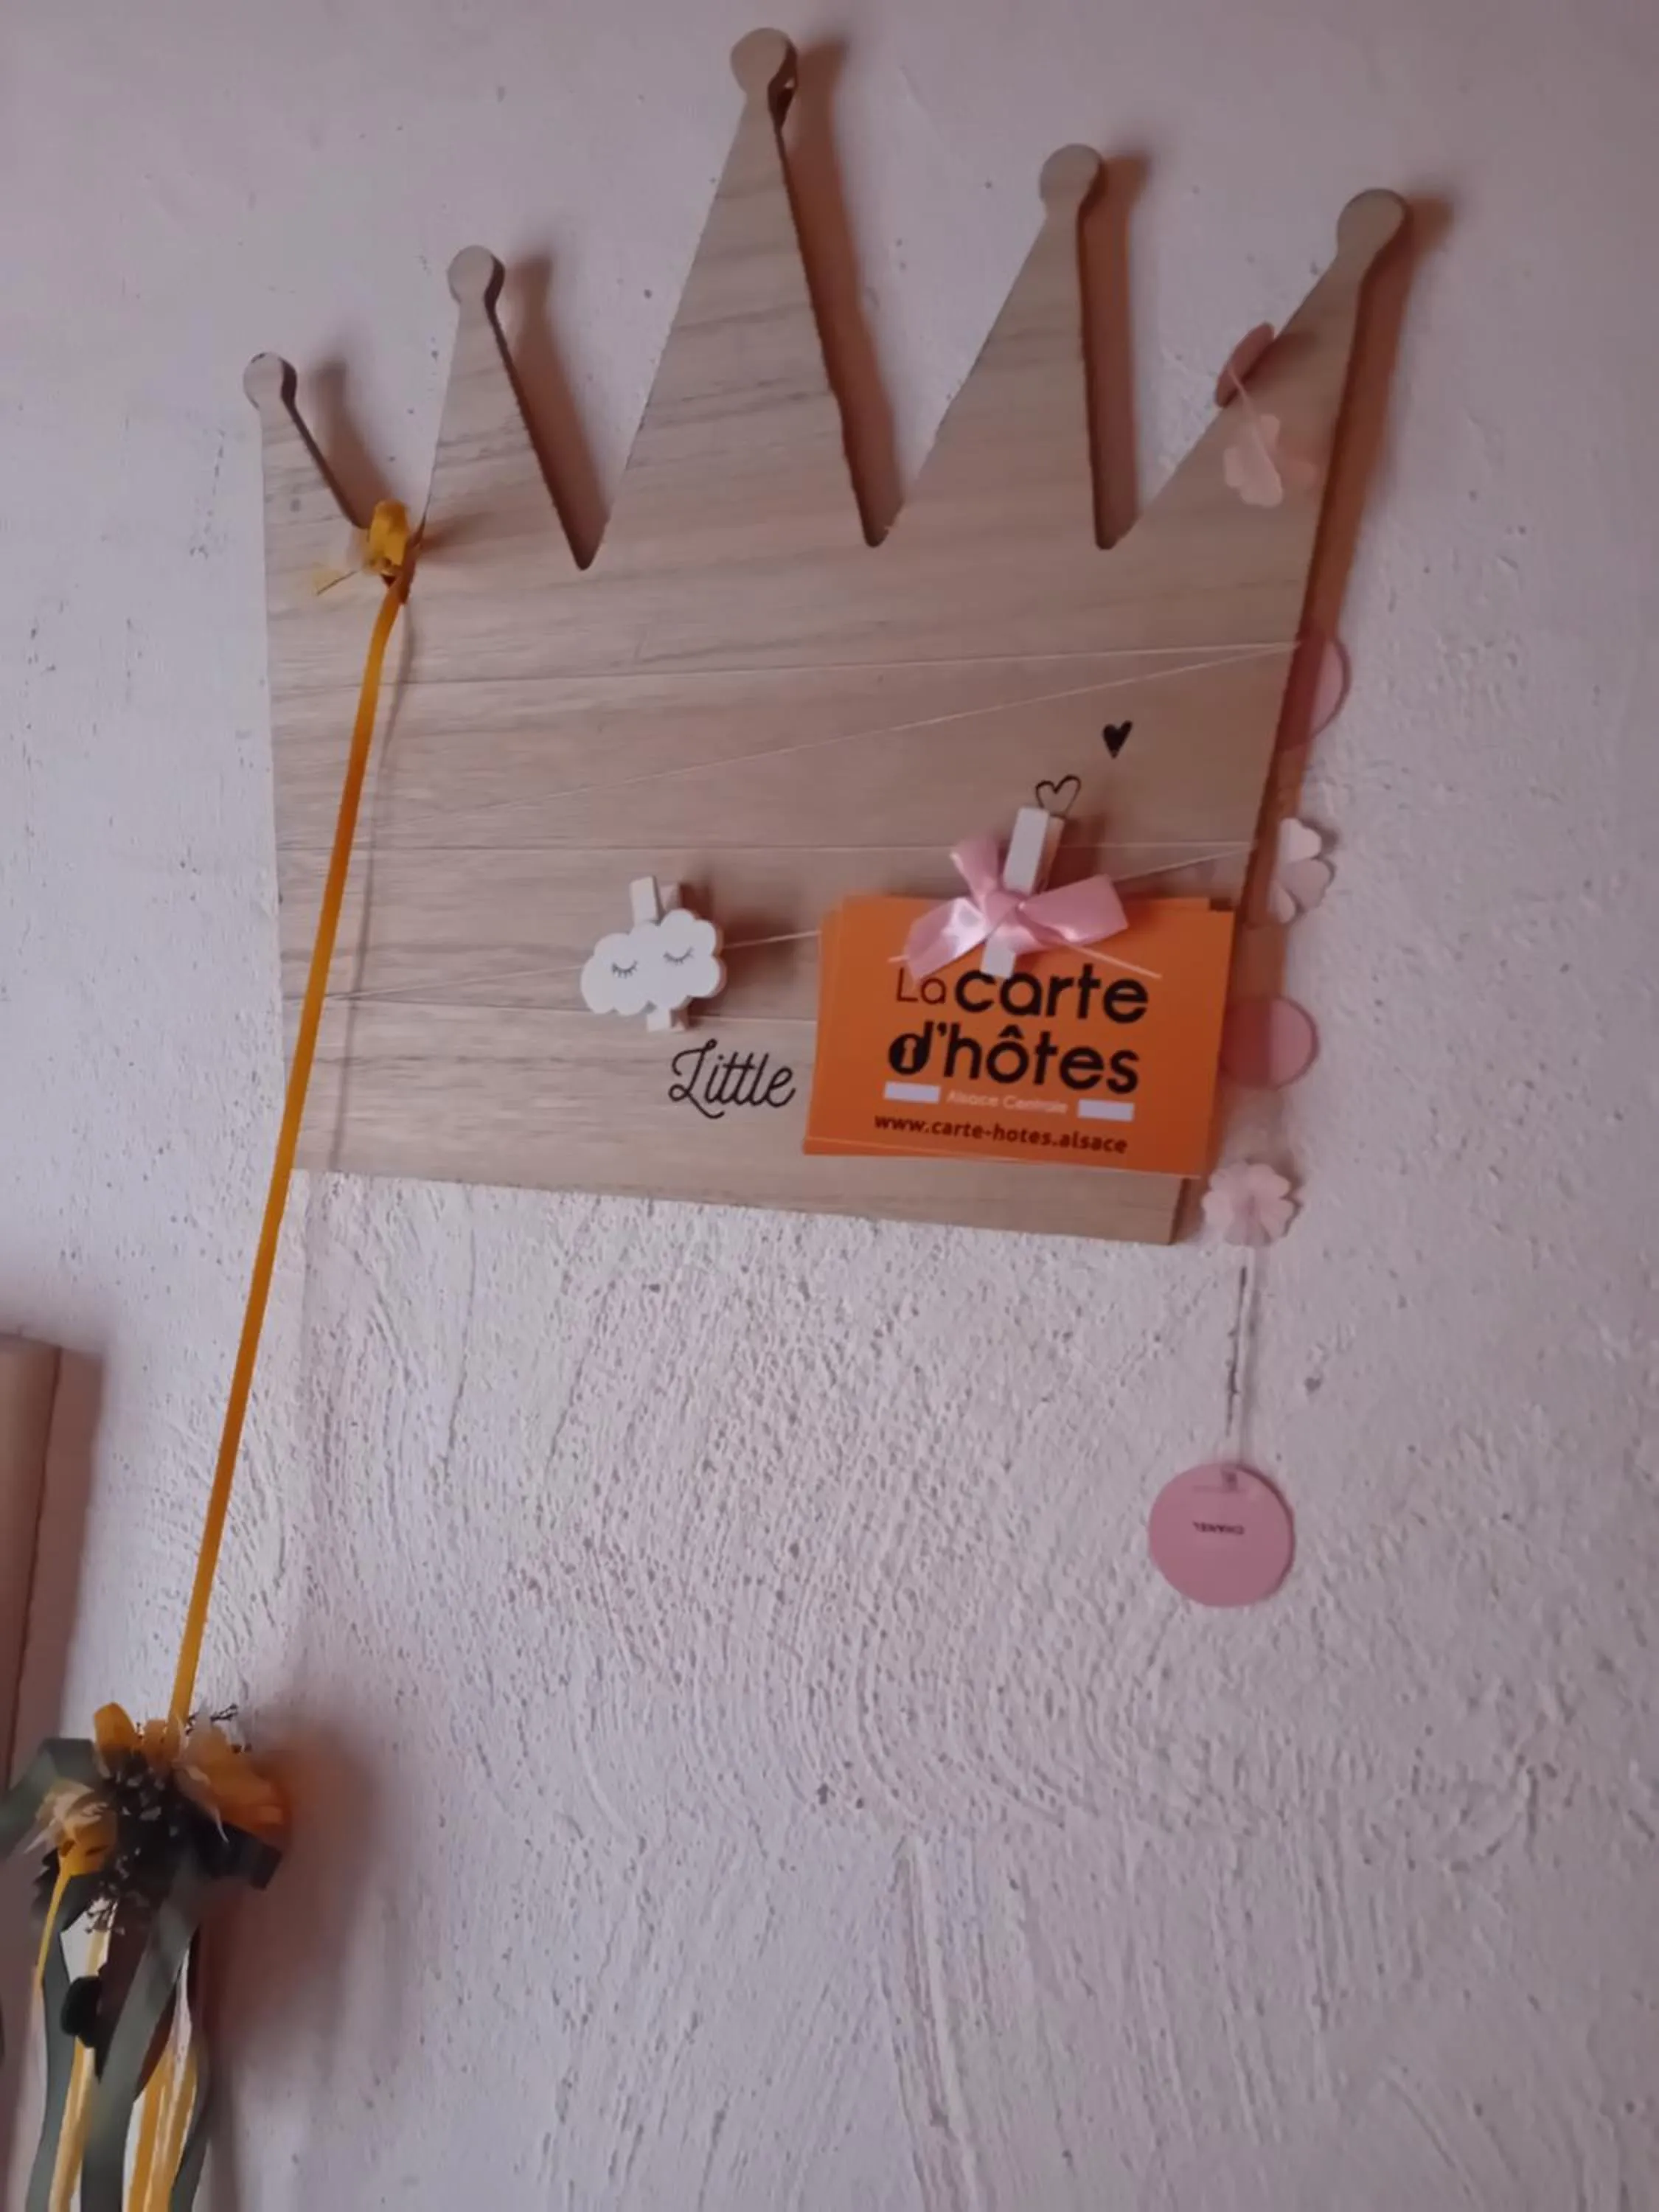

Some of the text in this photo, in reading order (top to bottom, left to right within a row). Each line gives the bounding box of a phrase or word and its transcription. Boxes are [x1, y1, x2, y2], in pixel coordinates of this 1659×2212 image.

[897, 963, 1150, 1024] La carte
[667, 1037, 797, 1120] Little
[888, 1019, 1141, 1094] d'hôtes
[947, 1089, 999, 1106] Alsace
[874, 1113, 1128, 1155] www.carte-hotes.alsace
